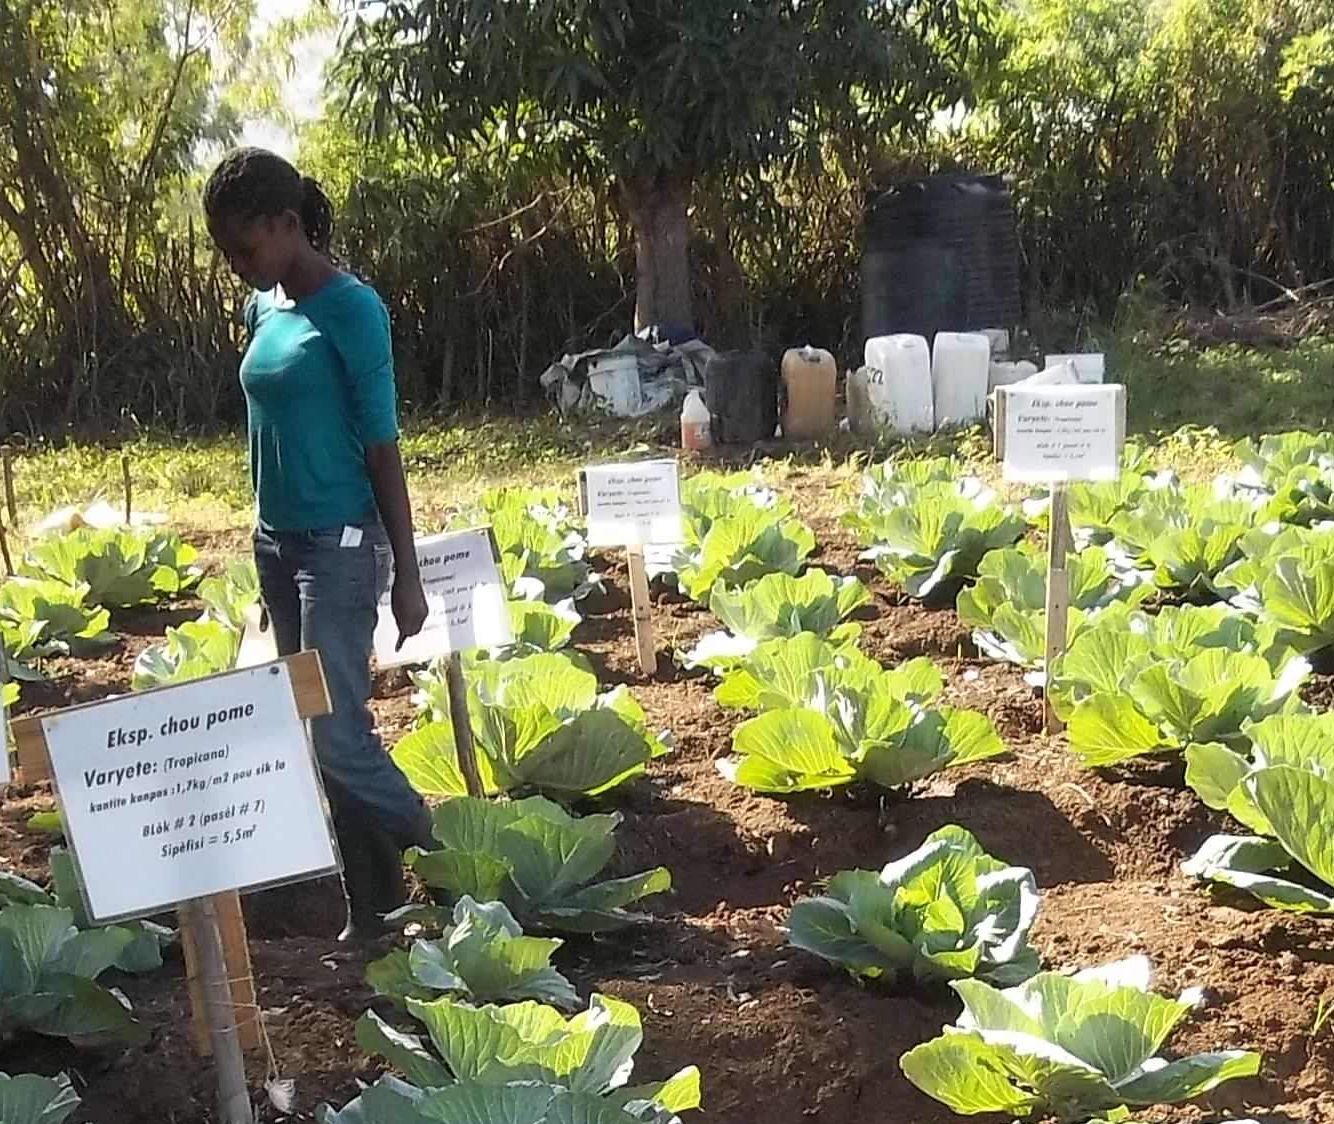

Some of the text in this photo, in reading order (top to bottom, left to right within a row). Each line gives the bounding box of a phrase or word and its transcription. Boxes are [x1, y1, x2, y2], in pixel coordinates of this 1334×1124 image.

[107, 702, 254, 748] Eksp. chou pome
[84, 744, 229, 789] Varyete: (Tropicana)
[89, 796, 127, 814] kantite
[130, 787, 168, 804] konpos
[232, 769, 253, 785] pou
[256, 762, 271, 777] sik
[275, 759, 285, 772] la
[174, 816, 185, 830] #
[188, 814, 195, 828] 2
[239, 801, 250, 815] #
[253, 799, 265, 814] 7)
